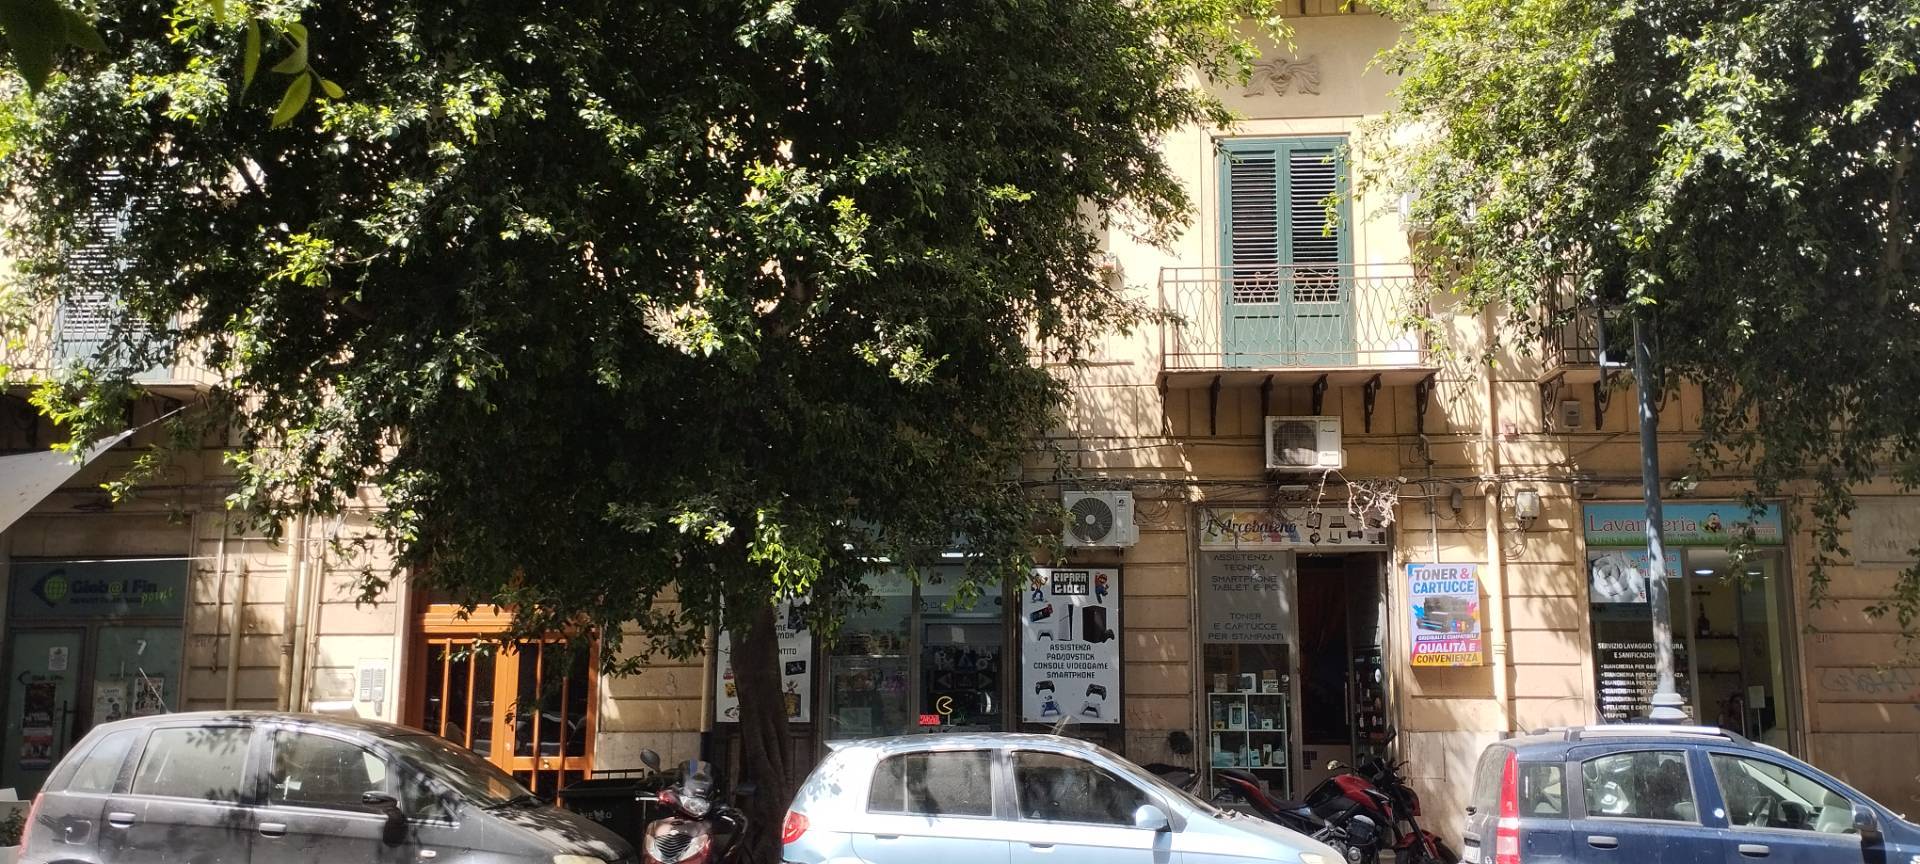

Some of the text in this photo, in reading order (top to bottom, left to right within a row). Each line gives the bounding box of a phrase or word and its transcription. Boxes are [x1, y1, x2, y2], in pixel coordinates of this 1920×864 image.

[1590, 512, 1698, 533] Lavaneria
[1214, 553, 1274, 561] ASSISTENZA
[1053, 572, 1087, 582] RIPARA
[1415, 567, 1469, 580] TONER &
[1054, 584, 1086, 594] GIOCA
[1413, 581, 1475, 594] CARTUCCE
[1231, 612, 1262, 620] TONER
[1231, 633, 1284, 641] STAMPANTI
[137, 639, 147, 655] 7
[1418, 641, 1476, 653] QUALITÀ E
[1416, 654, 1478, 664] CONVENIENZA
[1034, 662, 1108, 670] CONSOLE VIDEOGAME
[1047, 671, 1096, 679] SMARTPHONE
